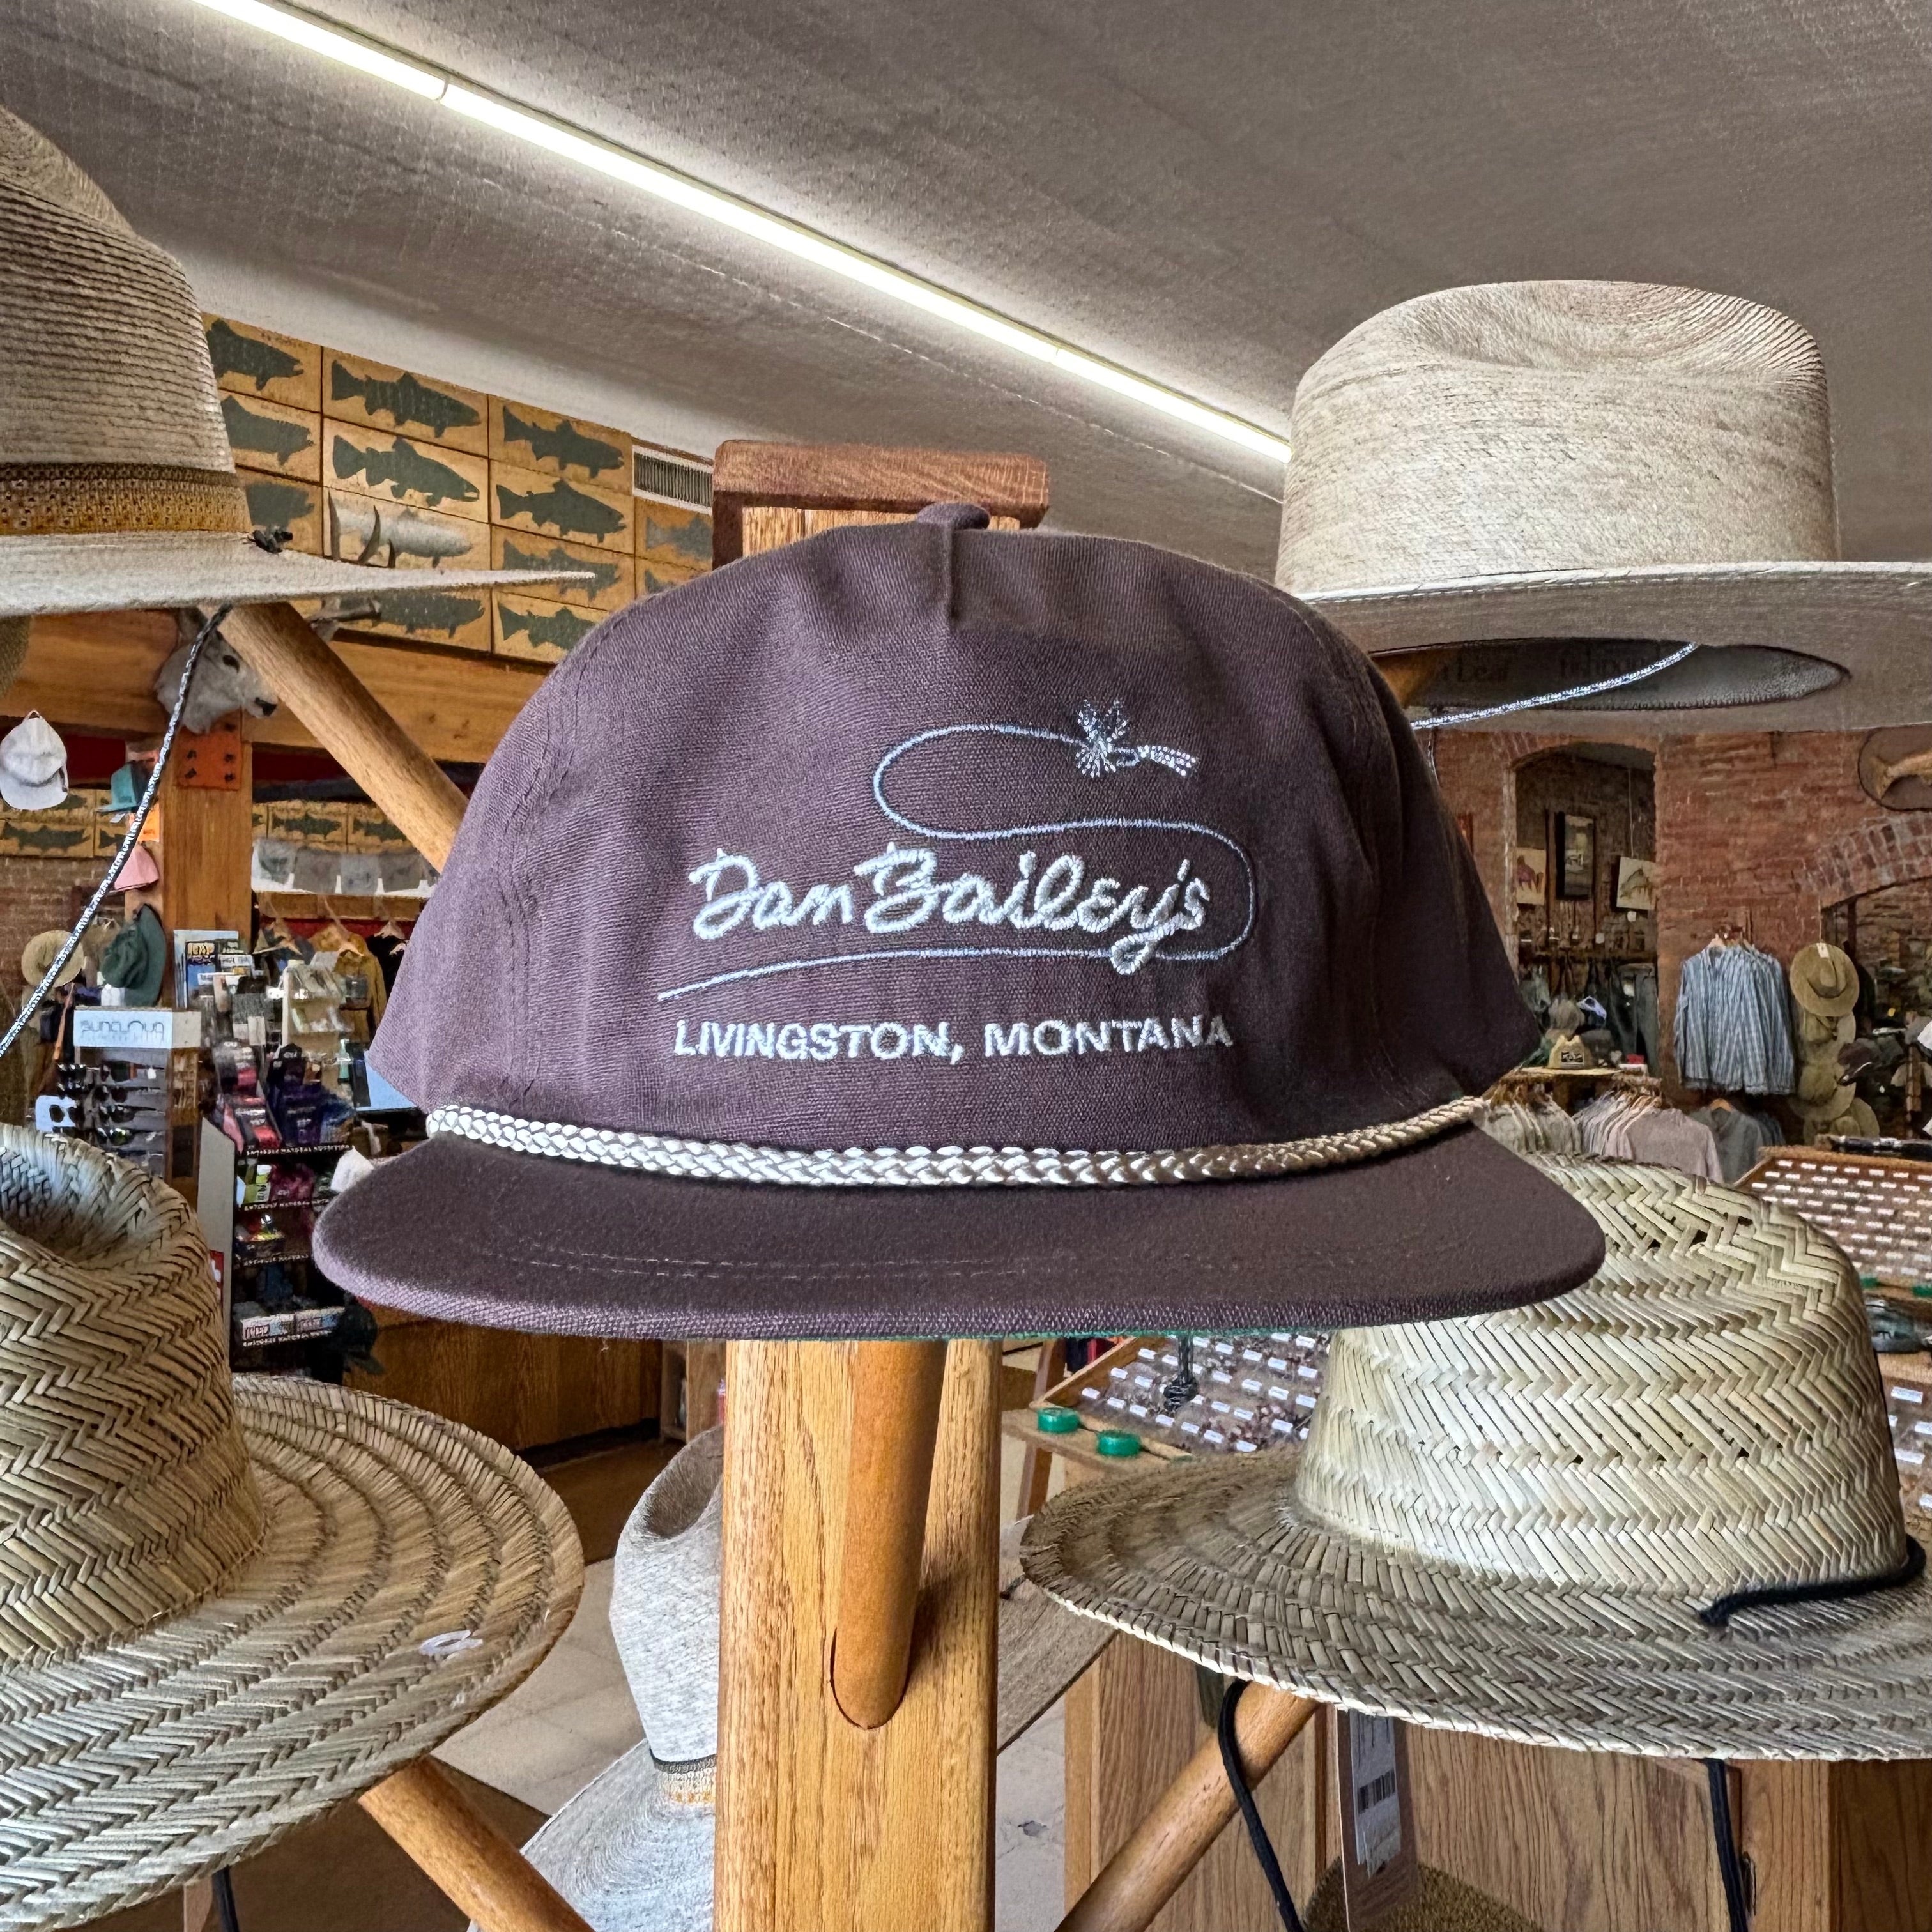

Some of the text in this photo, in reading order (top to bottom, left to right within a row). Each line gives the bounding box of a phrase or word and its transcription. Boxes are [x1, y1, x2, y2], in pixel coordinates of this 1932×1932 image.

[689, 841, 1210, 975] Dan Bailey's
[673, 1015, 1234, 1064] LIVINGSTON, MONTANA
